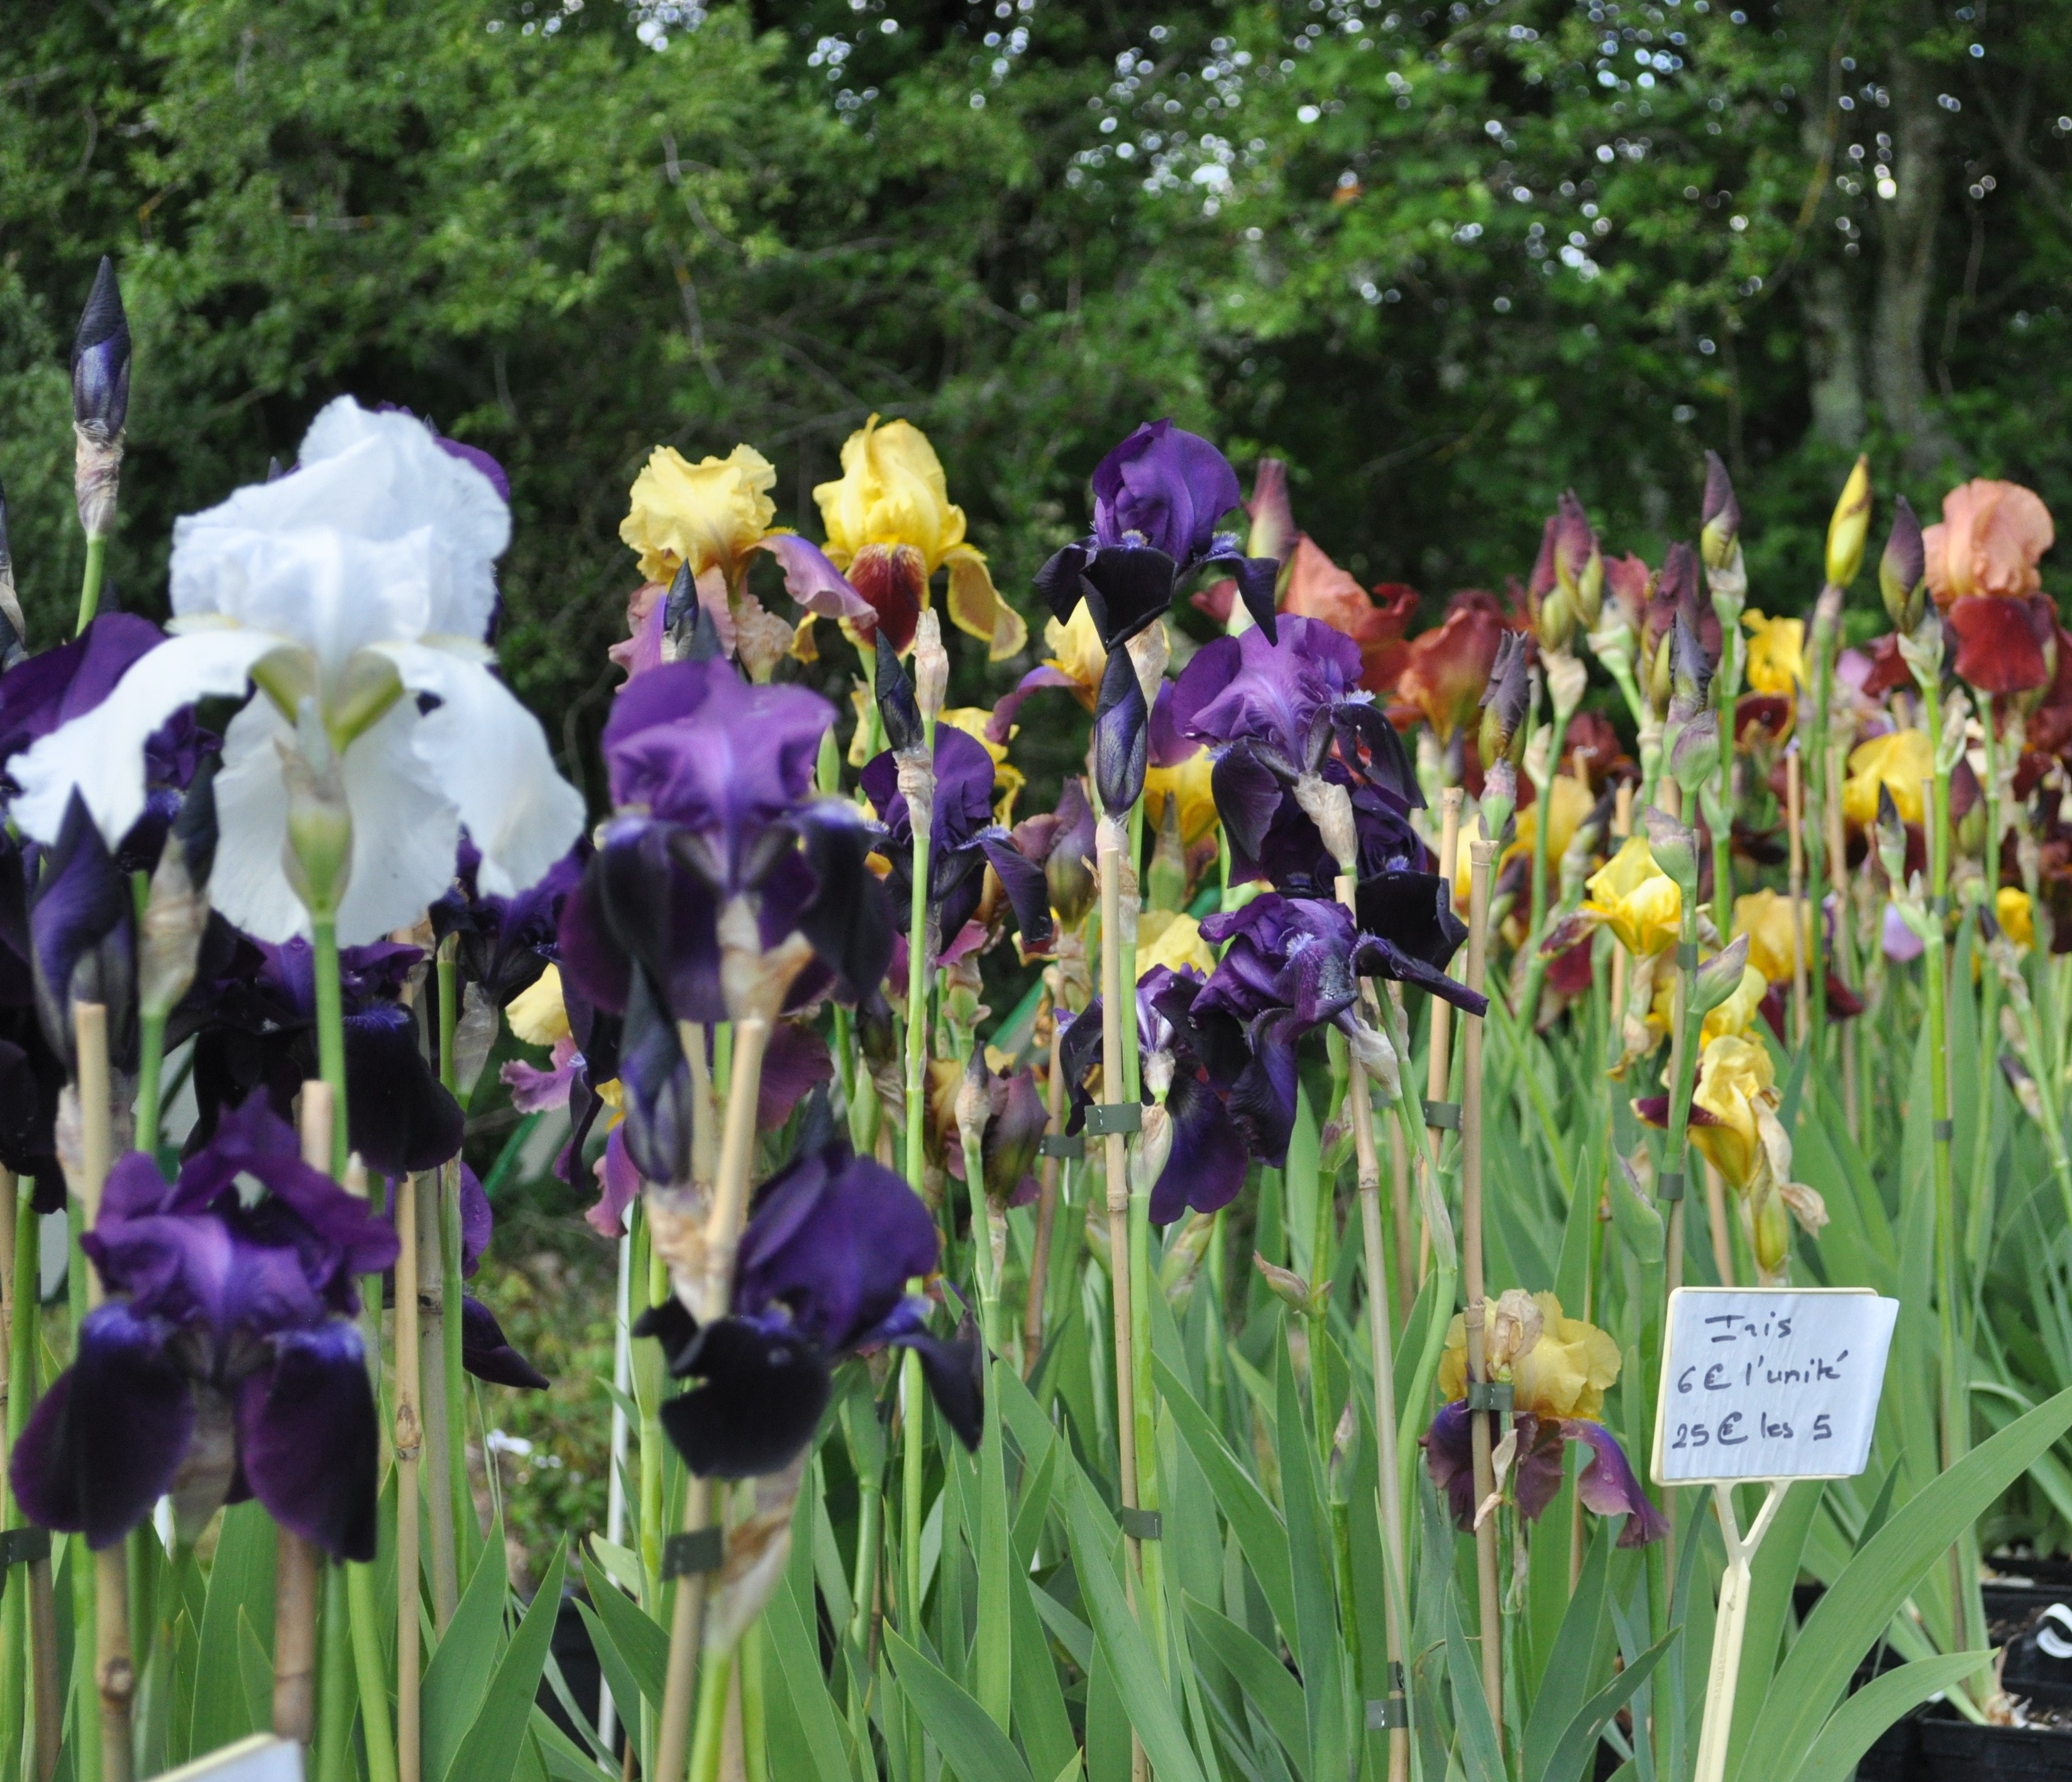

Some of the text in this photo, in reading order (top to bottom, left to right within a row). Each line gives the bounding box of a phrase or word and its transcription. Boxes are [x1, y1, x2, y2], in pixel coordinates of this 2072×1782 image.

[1704, 1311, 1792, 1342] Iris
[1760, 1411, 1794, 1439] les
[1812, 1414, 1832, 1441] 5
